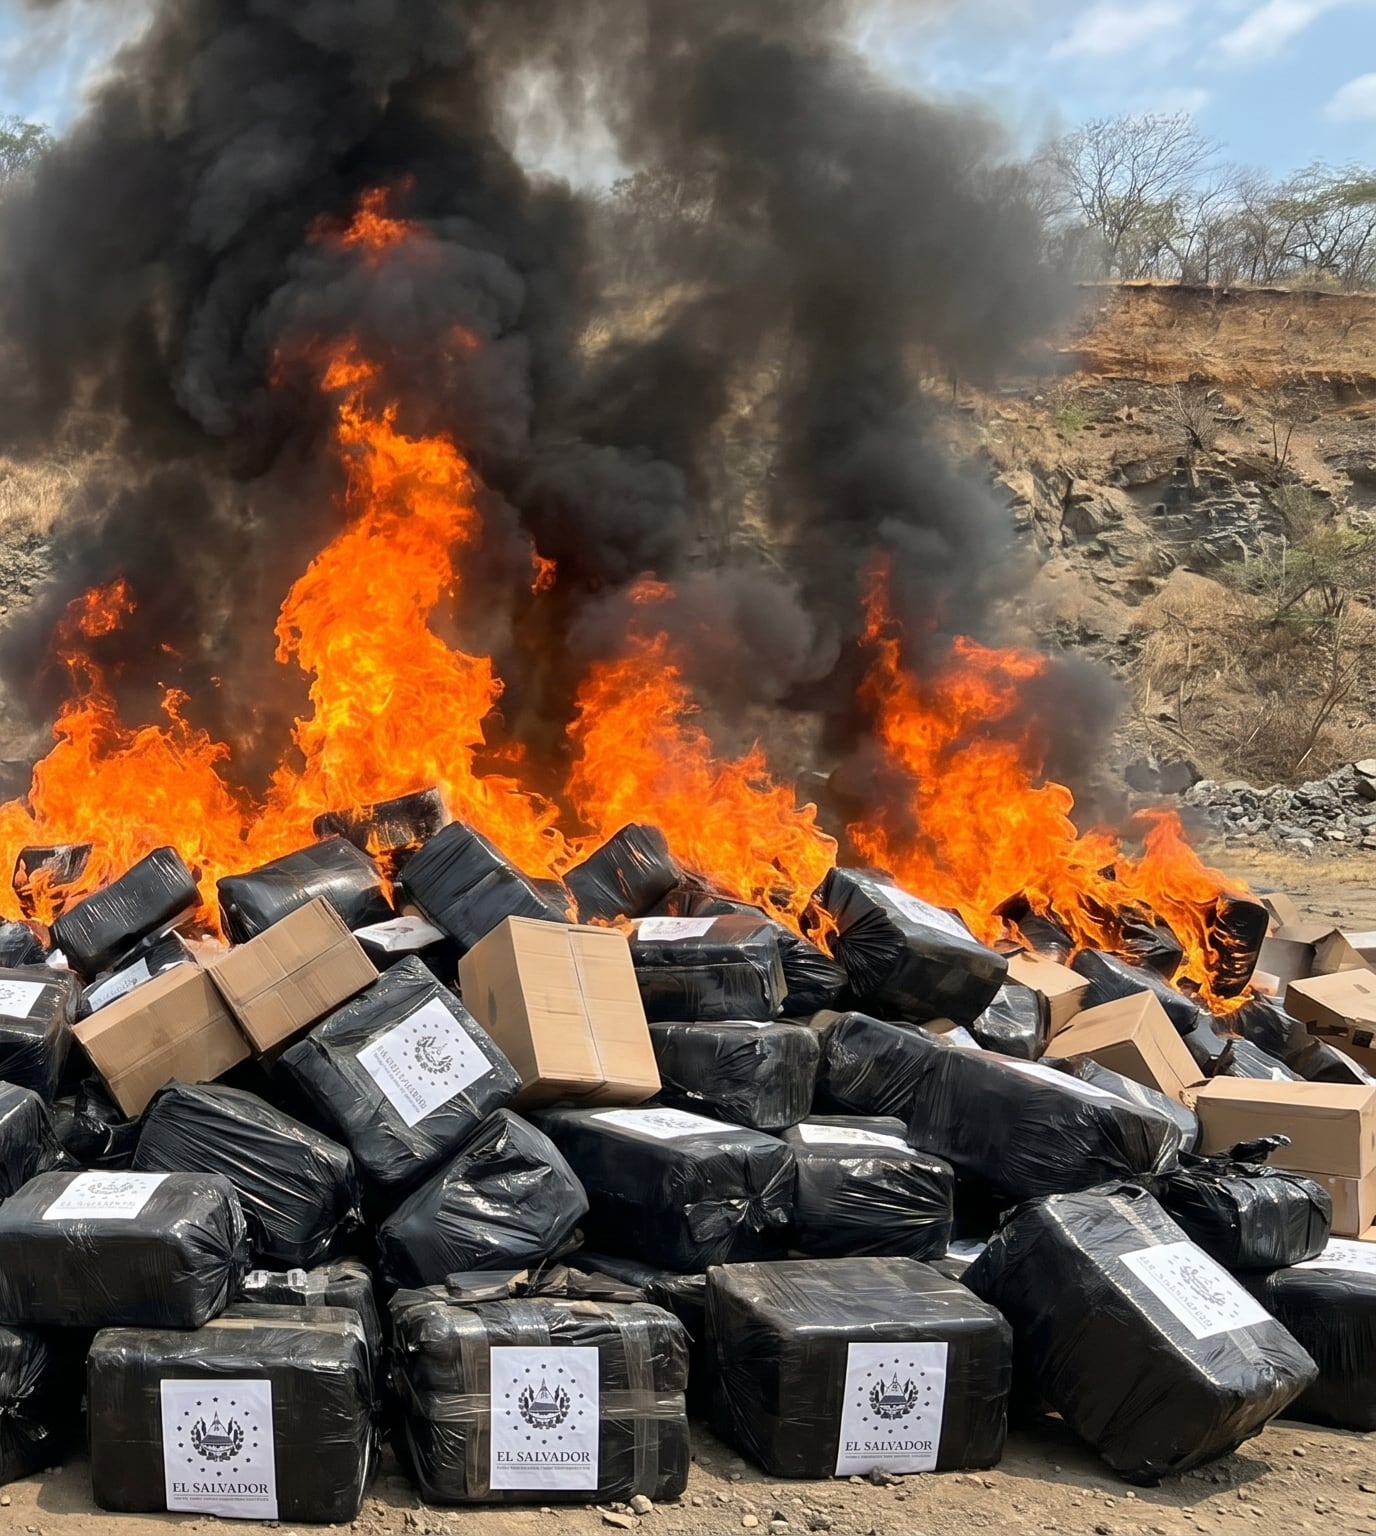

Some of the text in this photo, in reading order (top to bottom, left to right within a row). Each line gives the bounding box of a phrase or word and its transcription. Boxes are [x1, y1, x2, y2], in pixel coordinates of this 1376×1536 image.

[845, 1440, 932, 1451] EL SALVADOR
[497, 1451, 591, 1462] EL SALVADOR
[172, 1482, 269, 1494] EL SALVADOR
